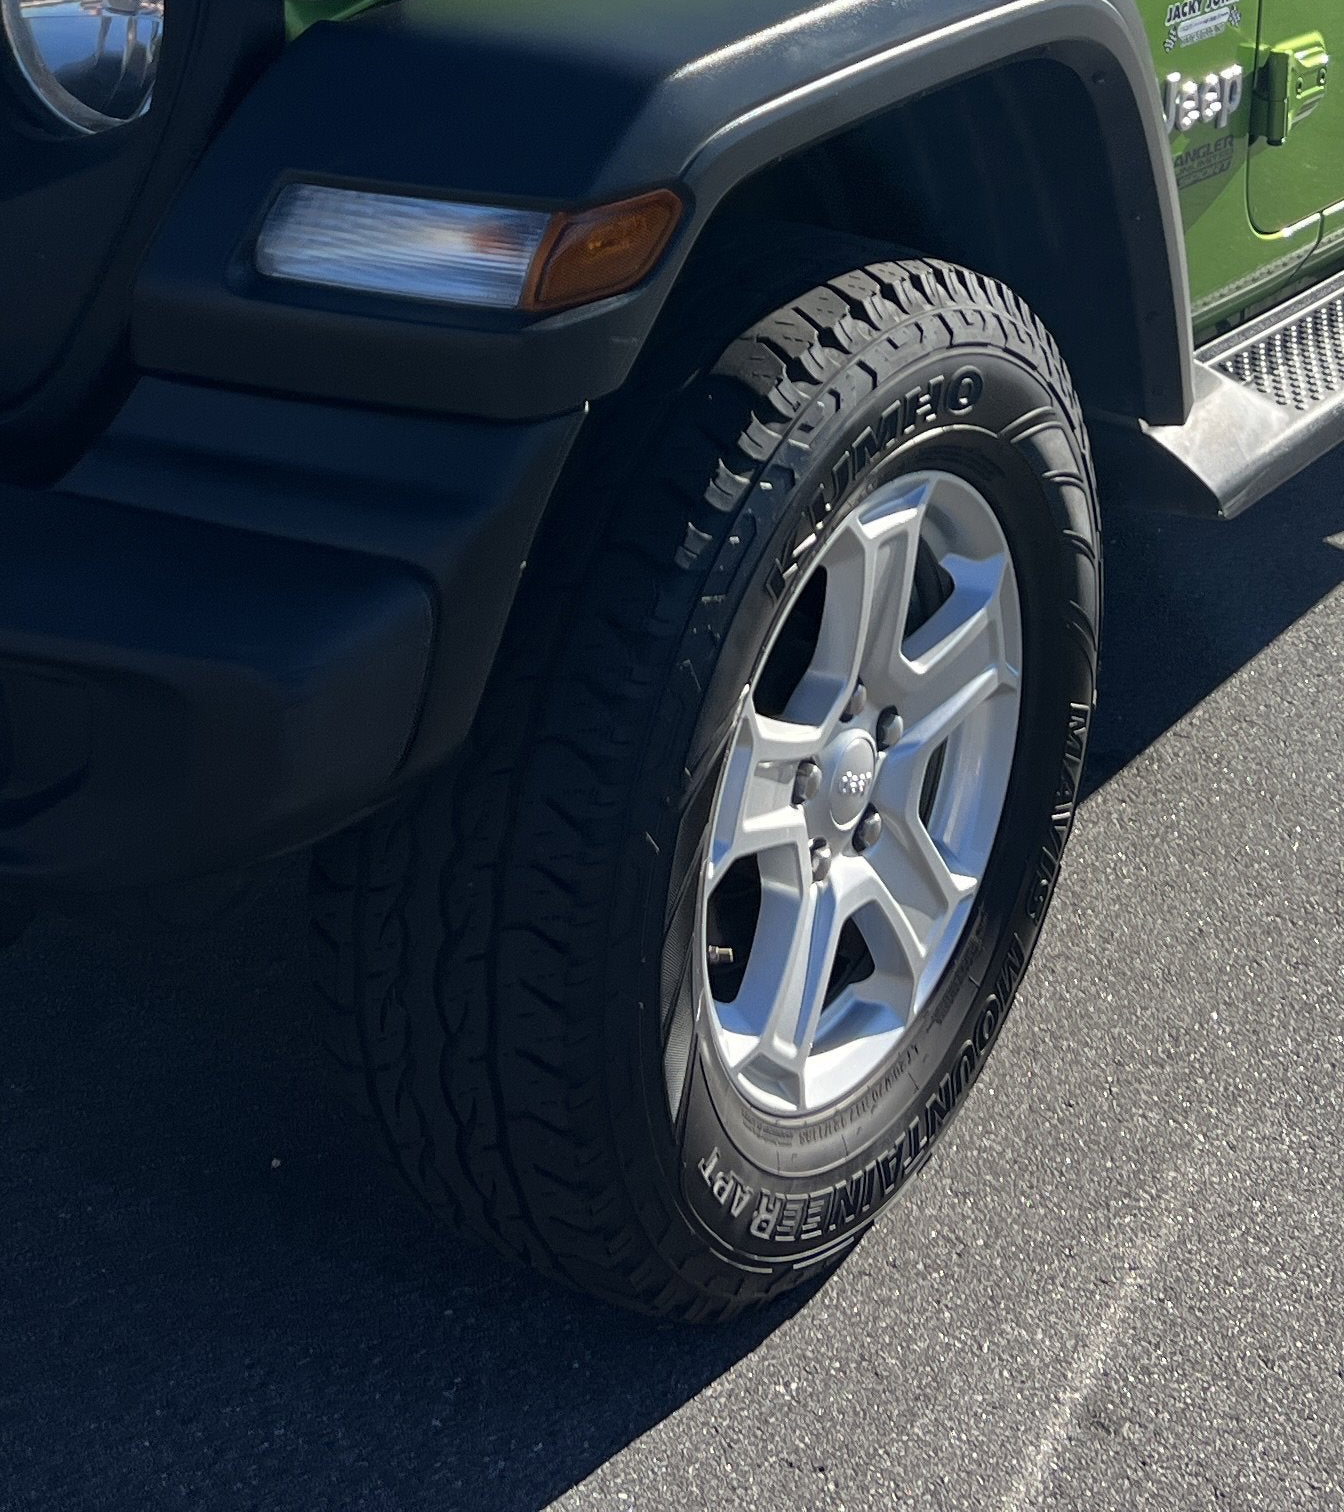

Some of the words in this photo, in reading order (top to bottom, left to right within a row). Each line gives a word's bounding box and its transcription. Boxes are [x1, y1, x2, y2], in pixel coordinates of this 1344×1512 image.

[1164, 64, 1243, 135] Jeep
[1174, 134, 1234, 167] ANGLER
[765, 364, 984, 606] KUMHO
[749, 931, 1028, 1244] MOUNTAINEER
